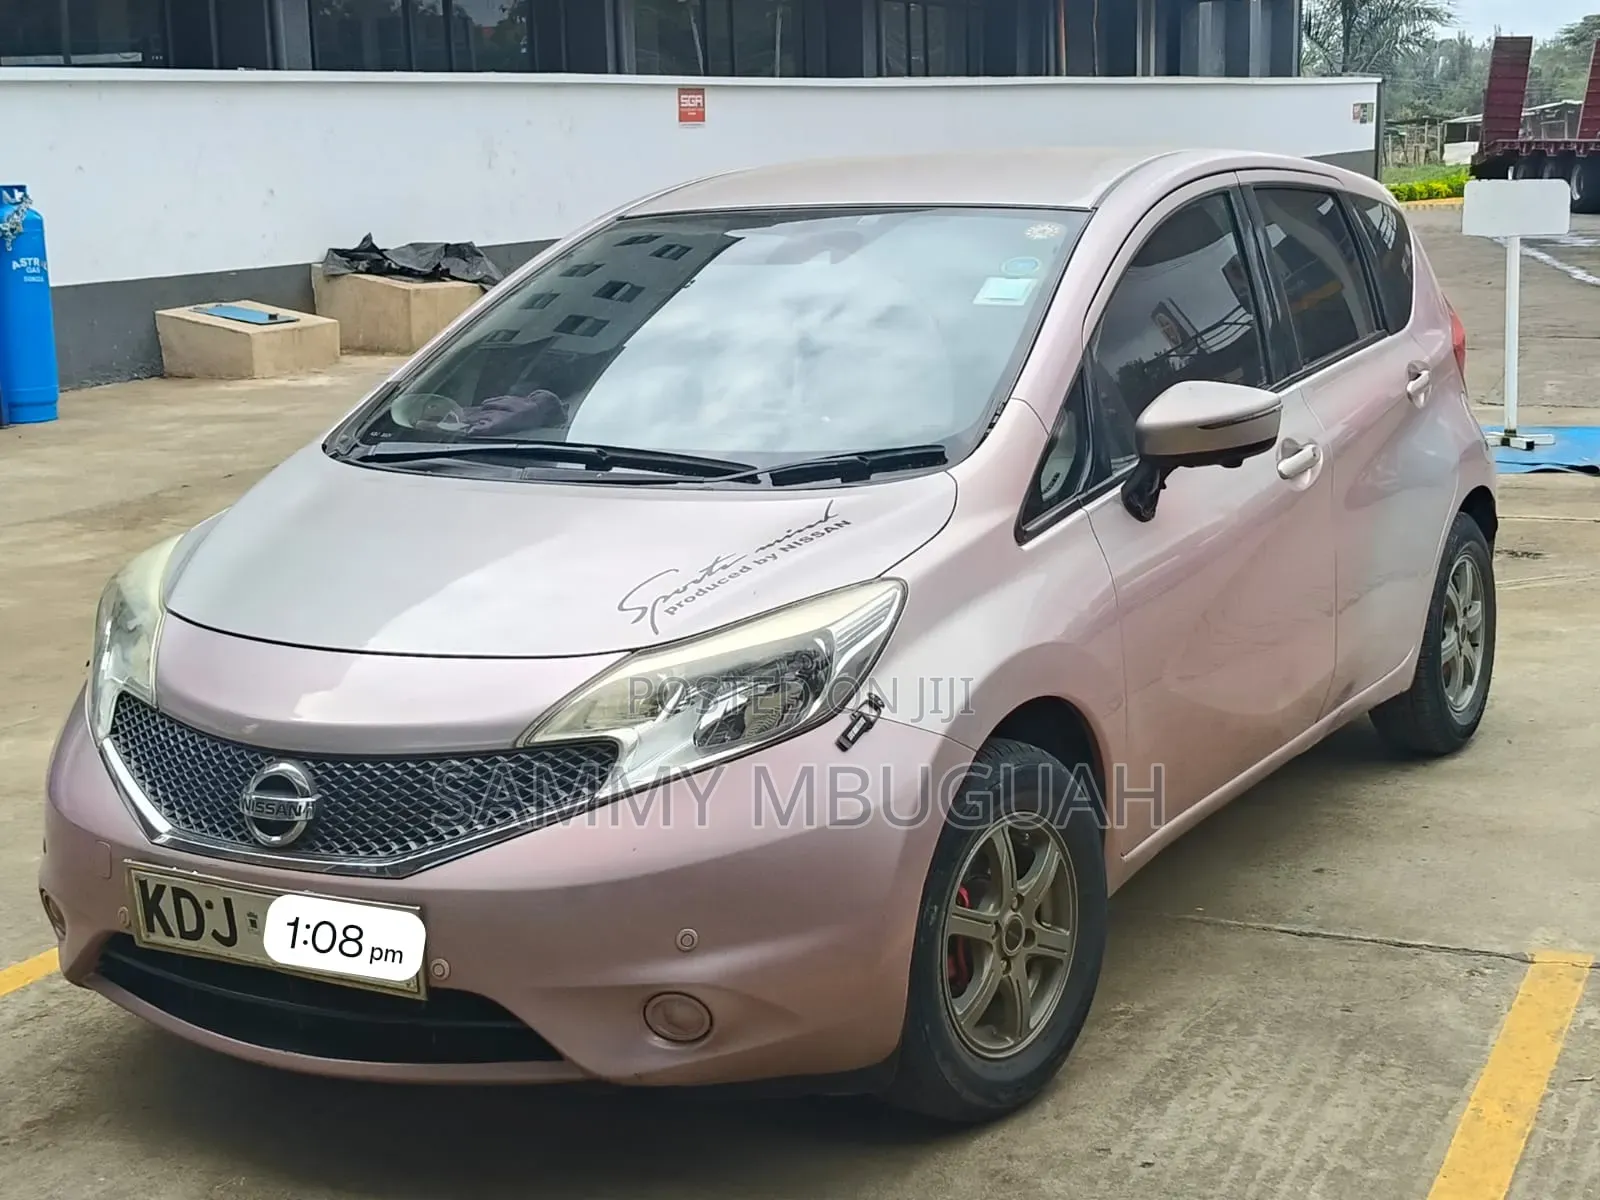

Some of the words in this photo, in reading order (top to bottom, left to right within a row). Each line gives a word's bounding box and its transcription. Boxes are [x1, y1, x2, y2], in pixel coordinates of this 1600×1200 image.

[663, 565, 753, 616] produced
[753, 552, 779, 566] by
[779, 519, 852, 553] NISSAN
[242, 798, 303, 817] NISSAN
[138, 879, 238, 948] KDJ
